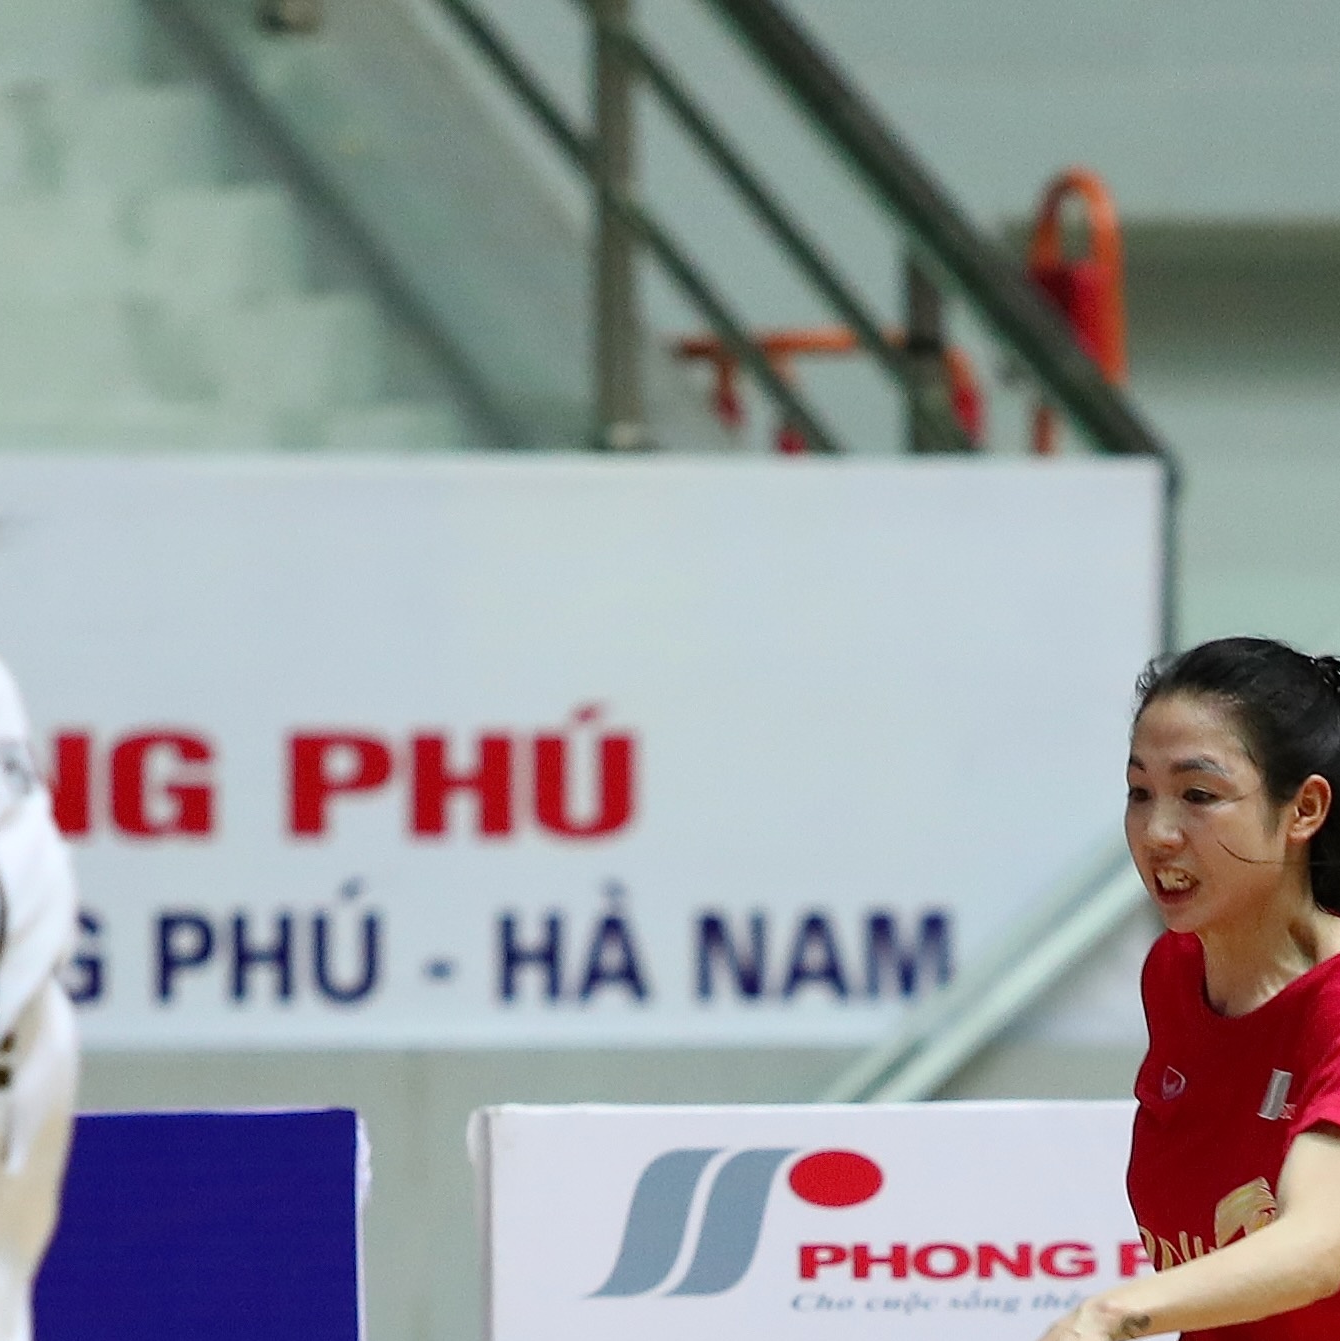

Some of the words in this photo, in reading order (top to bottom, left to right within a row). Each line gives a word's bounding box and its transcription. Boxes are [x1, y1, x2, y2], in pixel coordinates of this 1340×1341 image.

[287, 702, 637, 843] PHÚ
[155, 881, 383, 1007] PHÚ
[497, 882, 649, 1005] HÀ
[694, 908, 958, 1005] NAM
[791, 1292, 854, 1312] Cho
[797, 1241, 1097, 1281] PHONG
